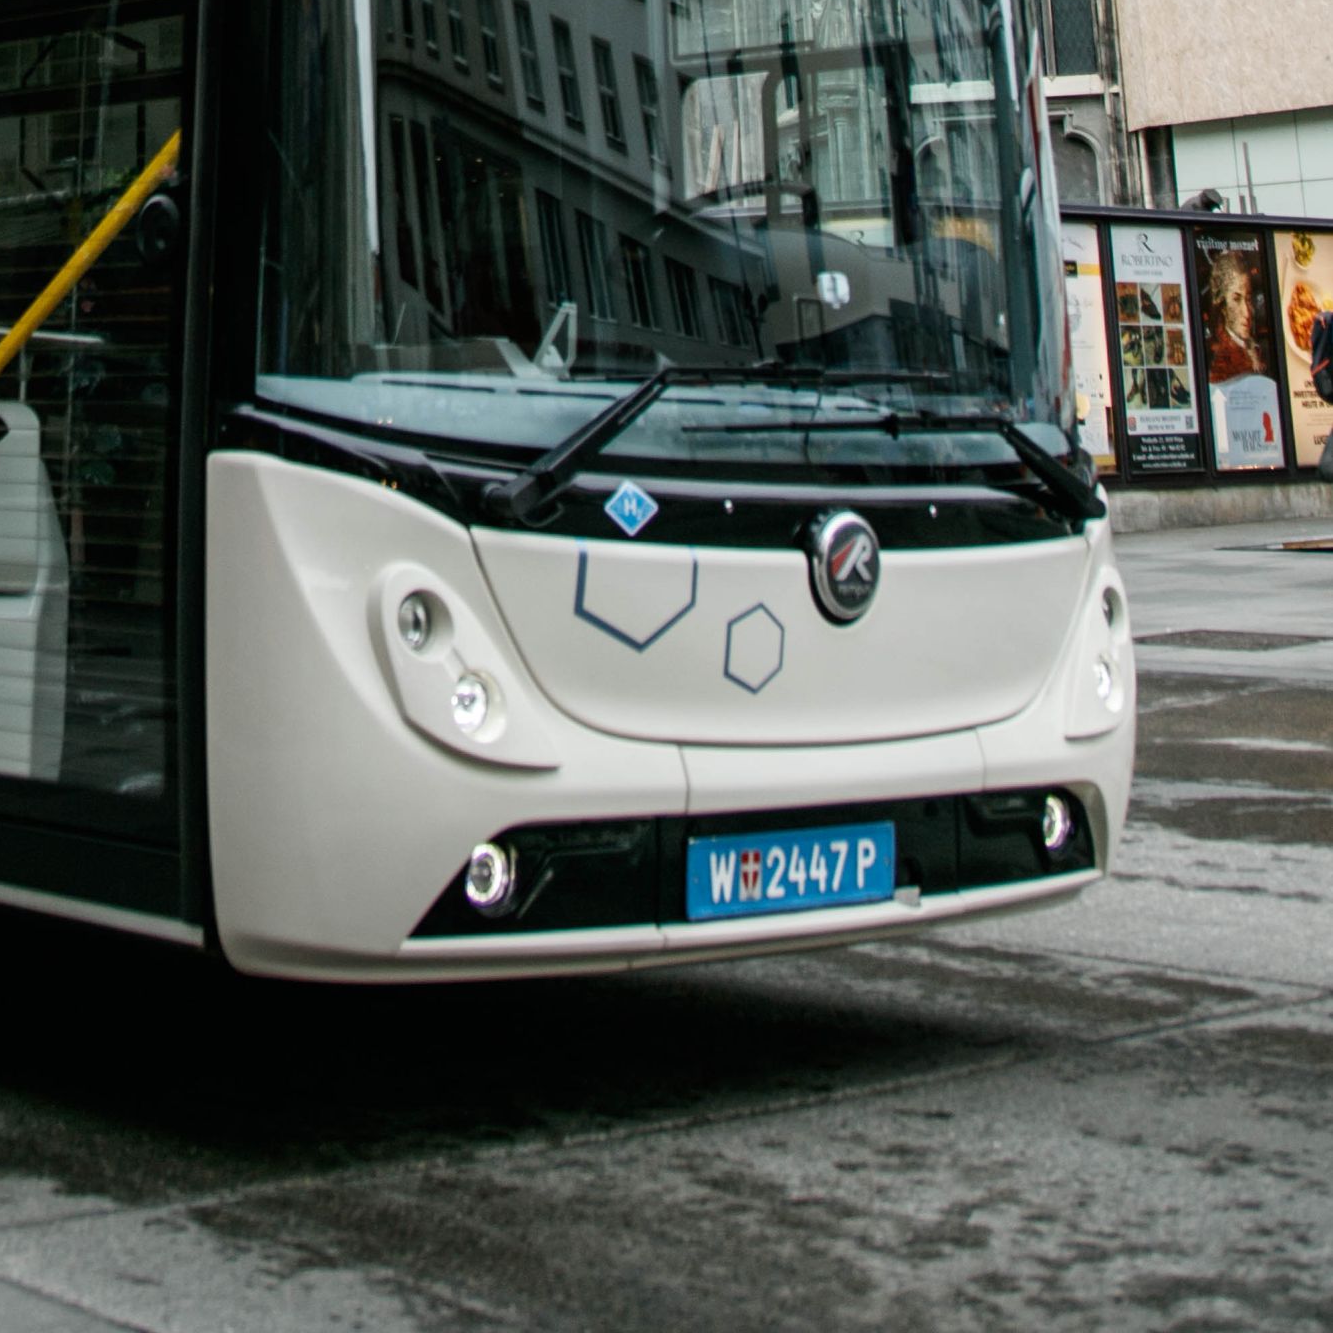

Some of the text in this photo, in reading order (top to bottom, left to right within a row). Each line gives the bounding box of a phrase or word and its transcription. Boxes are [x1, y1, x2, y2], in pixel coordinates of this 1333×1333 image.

[709, 838, 877, 904] W 2447 P
